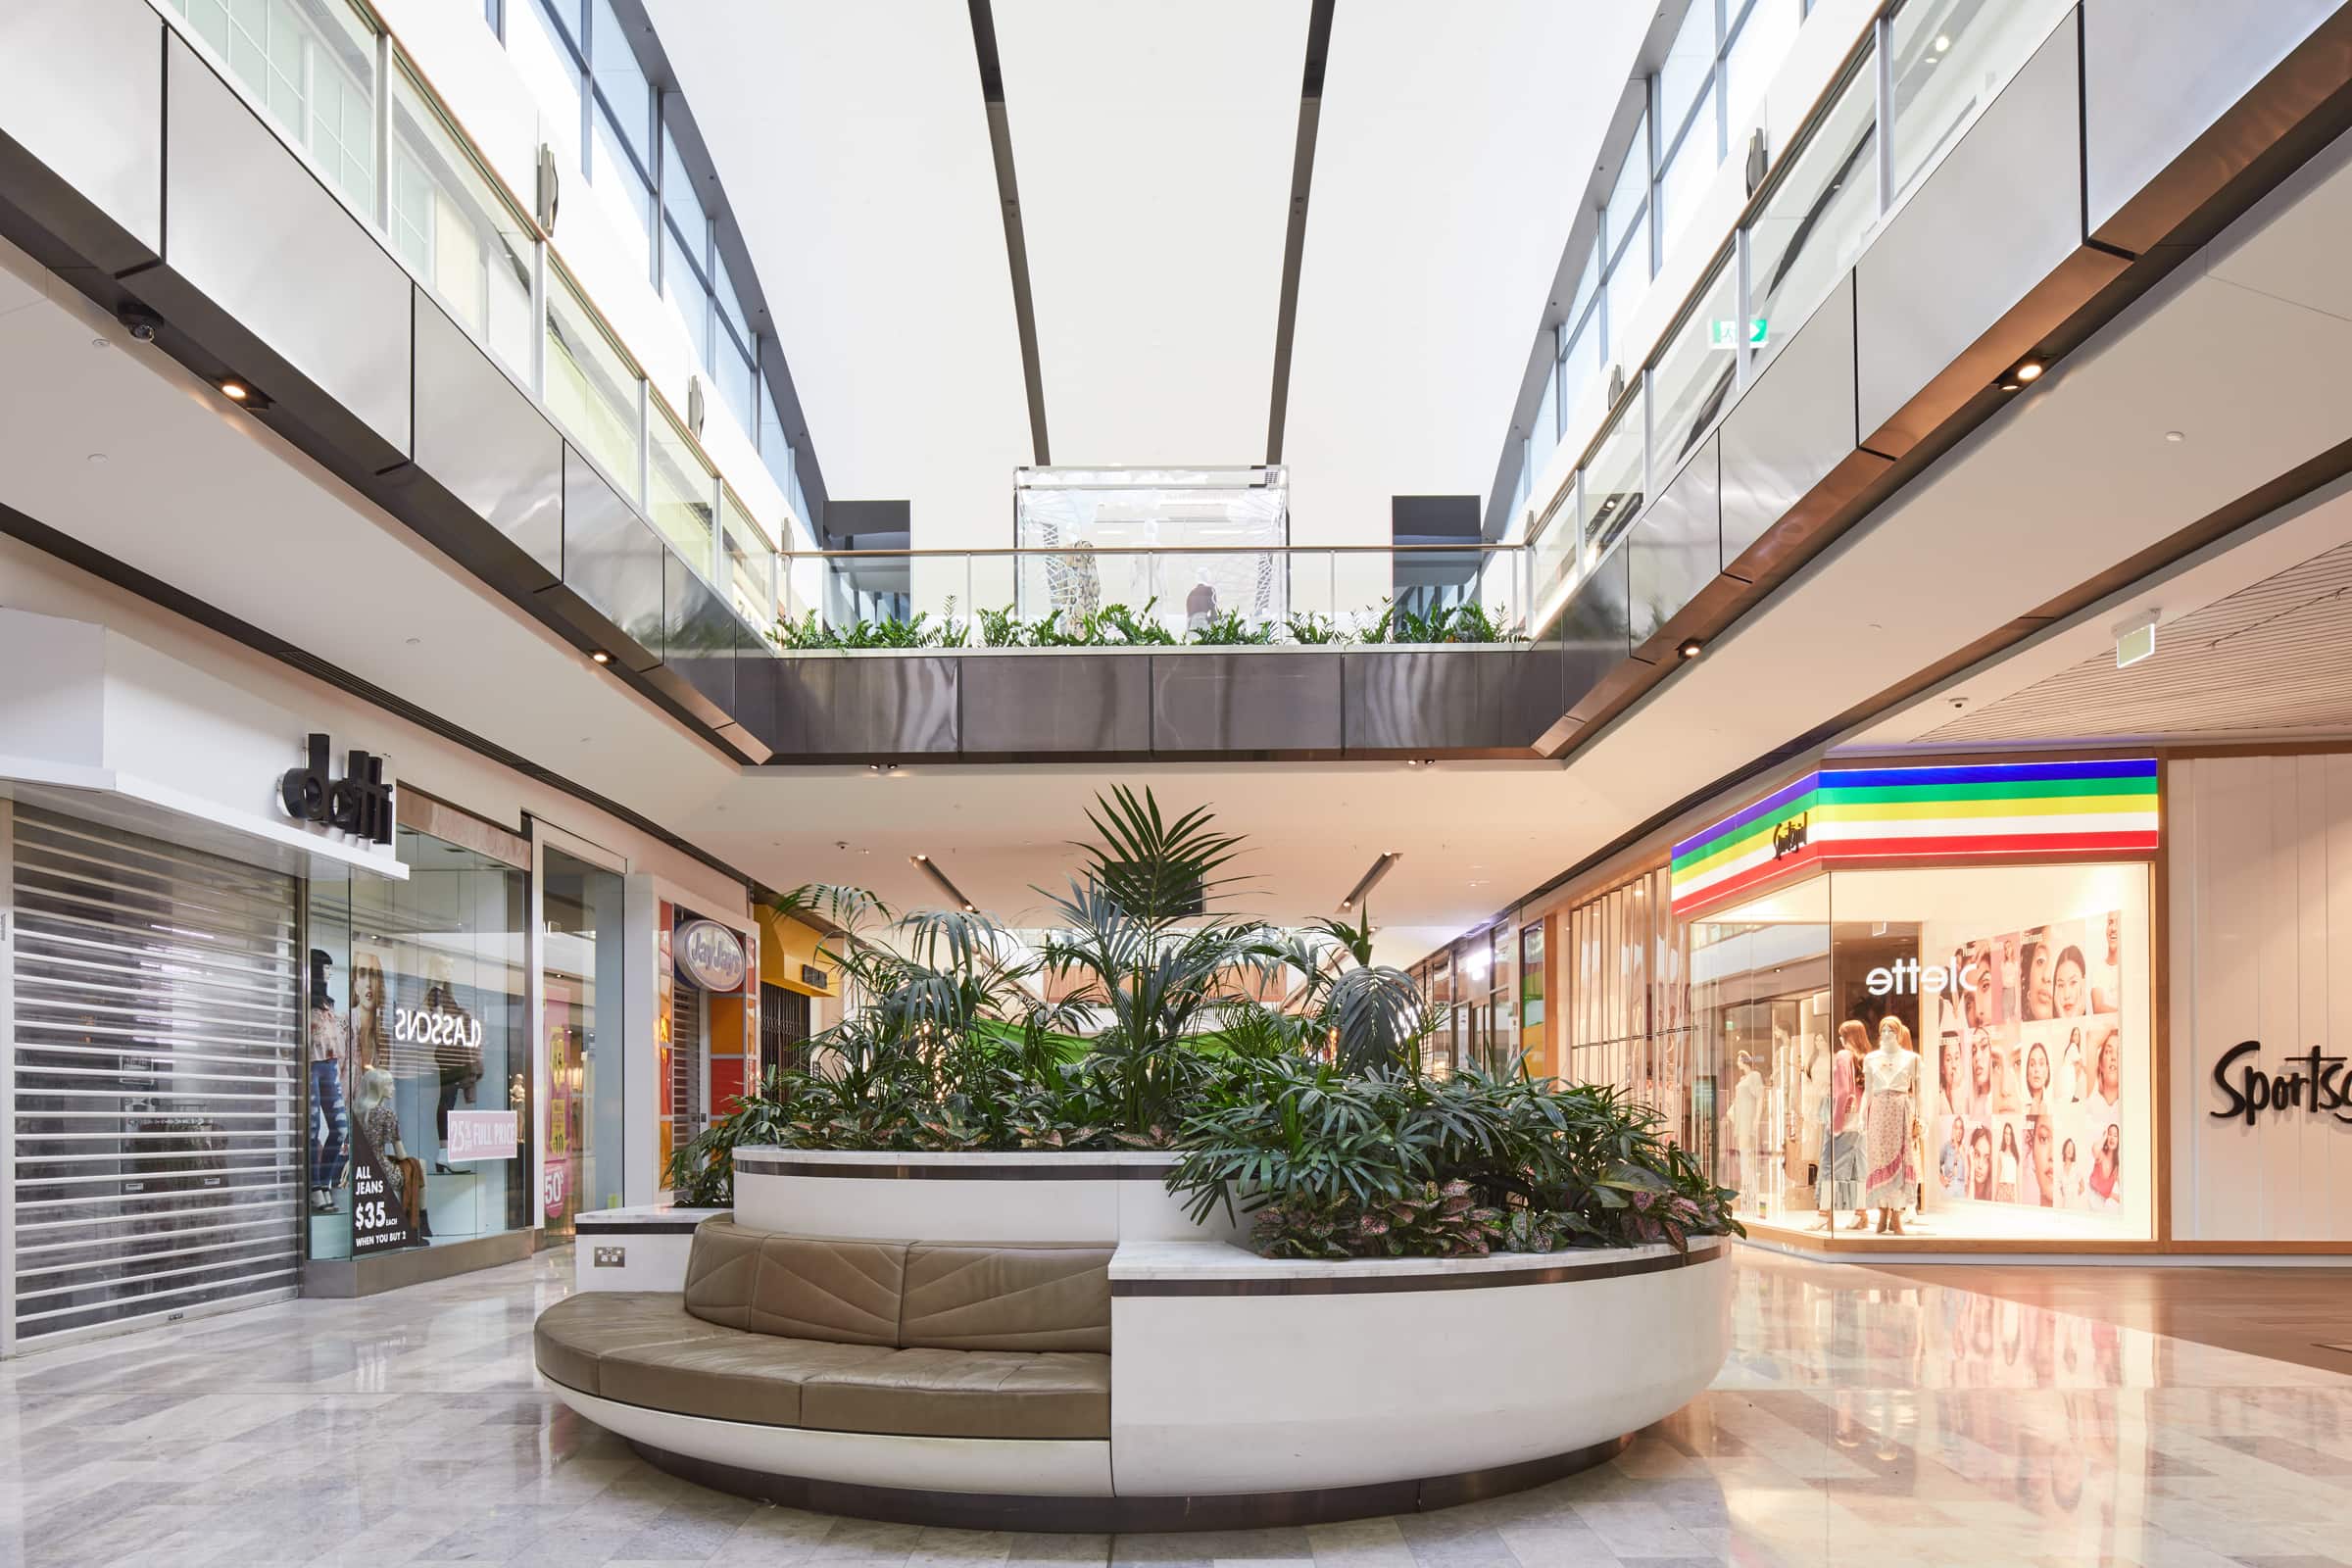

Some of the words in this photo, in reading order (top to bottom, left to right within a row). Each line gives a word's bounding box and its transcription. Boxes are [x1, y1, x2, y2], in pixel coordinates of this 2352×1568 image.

[282, 733, 393, 845] dotti
[473, 1122, 492, 1145] FULL
[494, 1122, 514, 1145] PRICE
[356, 1166, 371, 1180] ALL
[356, 1181, 383, 1195] JEANS
[356, 1201, 386, 1230] $35
[356, 1236, 374, 1247] WHEN
[375, 1234, 388, 1244] YOU
[389, 1232, 401, 1242] BUY
